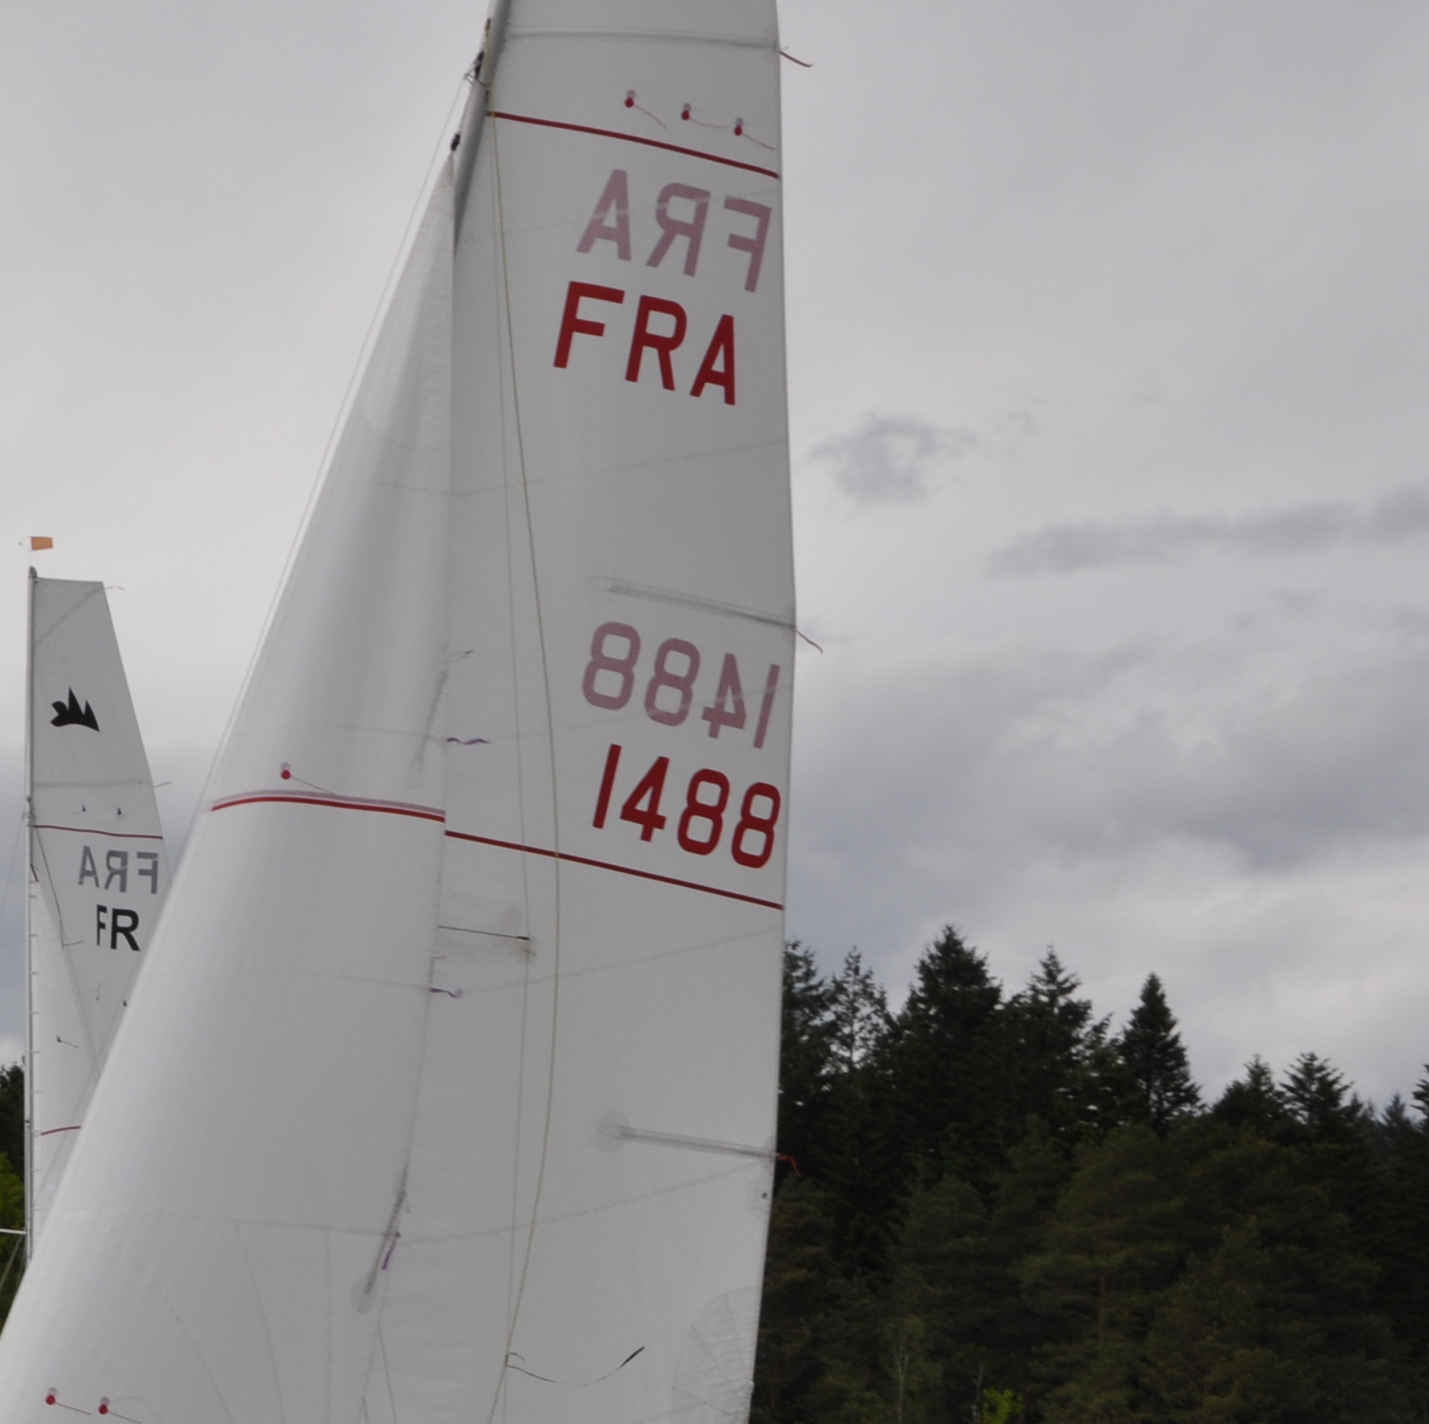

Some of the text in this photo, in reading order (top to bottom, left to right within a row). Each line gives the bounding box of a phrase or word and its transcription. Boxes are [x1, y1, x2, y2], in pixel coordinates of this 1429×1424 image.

[553, 280, 736, 406] FRA
[592, 743, 781, 869] 1488
[96, 904, 141, 951] FR
